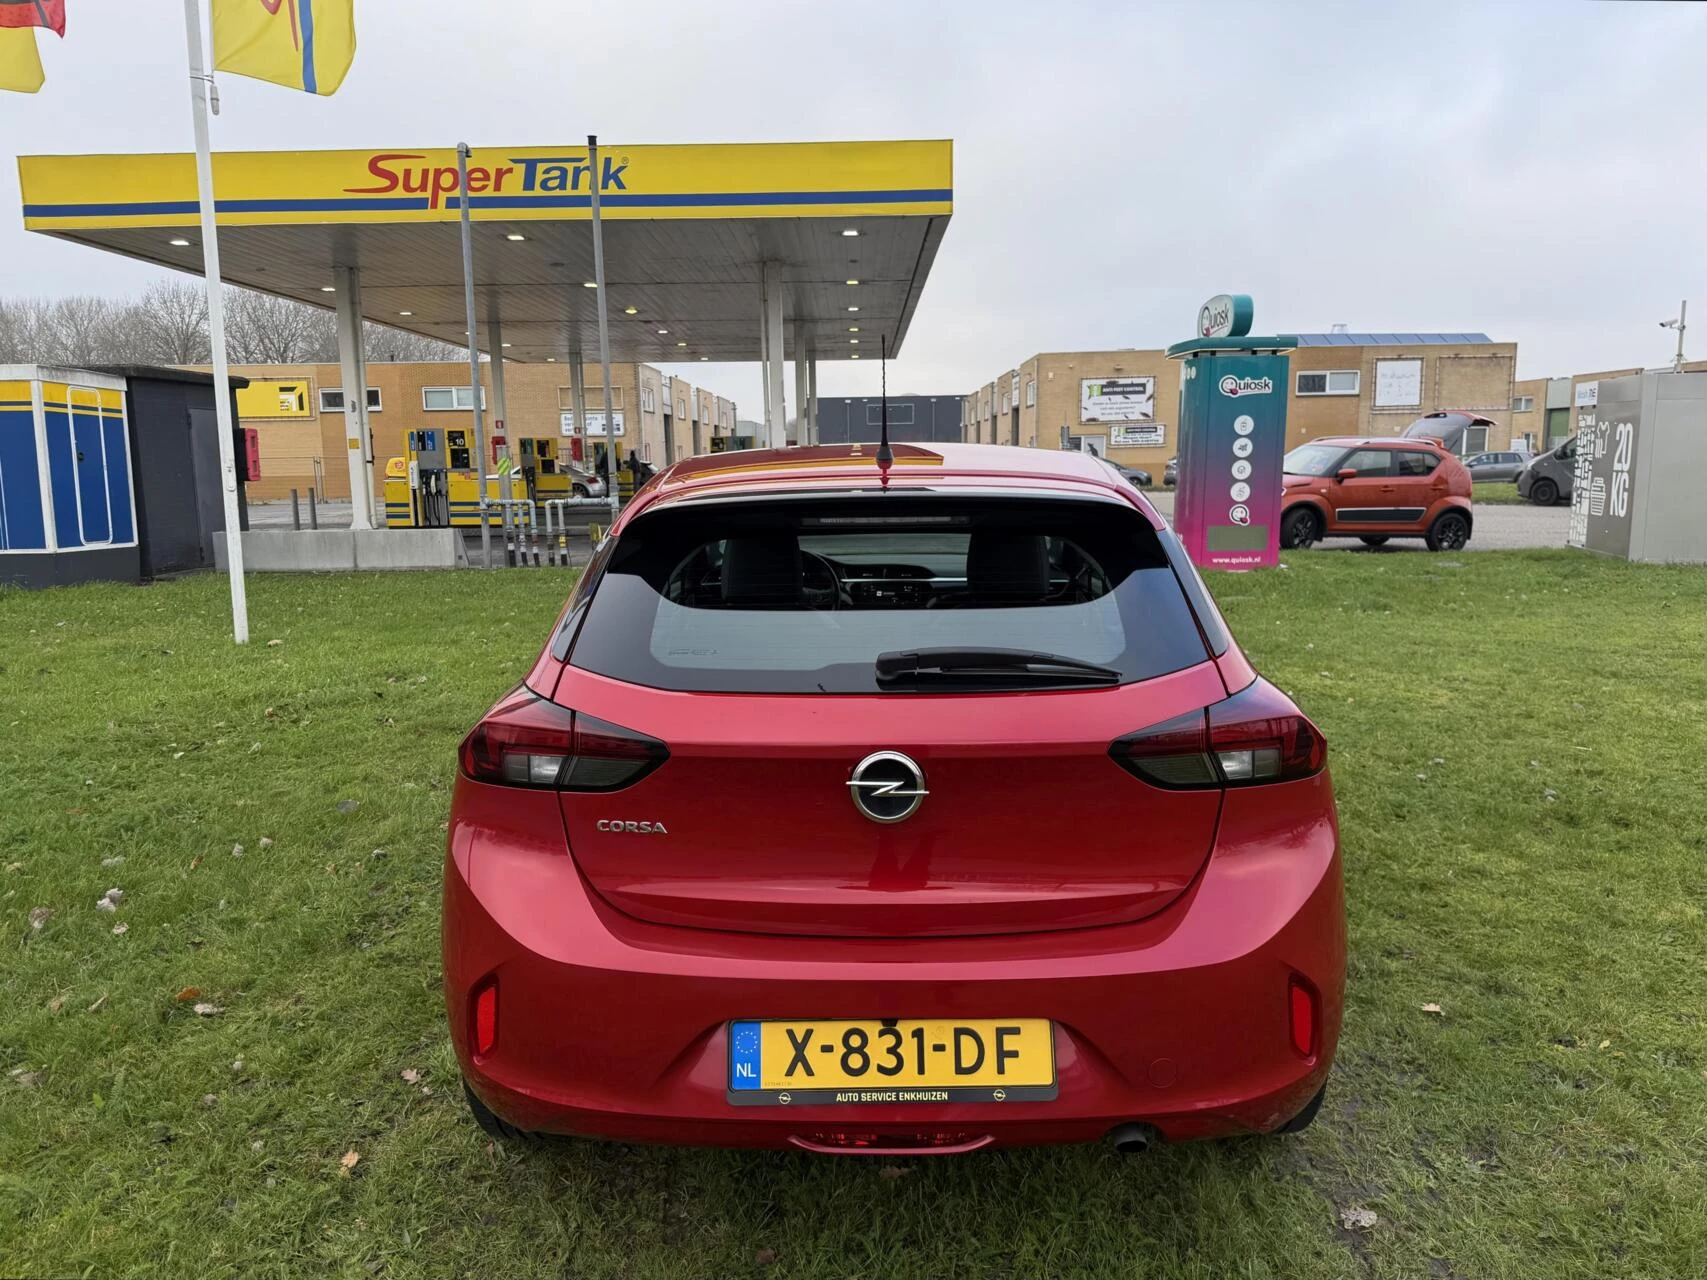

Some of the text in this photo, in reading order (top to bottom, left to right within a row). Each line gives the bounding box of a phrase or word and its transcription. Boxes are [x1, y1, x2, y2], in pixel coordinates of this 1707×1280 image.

[1201, 303, 1230, 337] Quiosk
[1220, 376, 1272, 395] Quiosk
[1613, 423, 1633, 471] 20
[1610, 472, 1629, 517] KG
[1212, 556, 1261, 564] www.quiosk.nl
[596, 819, 668, 834] CORSA
[784, 1027, 1021, 1077] X-831-DF
[736, 1063, 756, 1078] NL
[836, 1091, 948, 1102] AUTO SERVICE ENKHUIZEN
